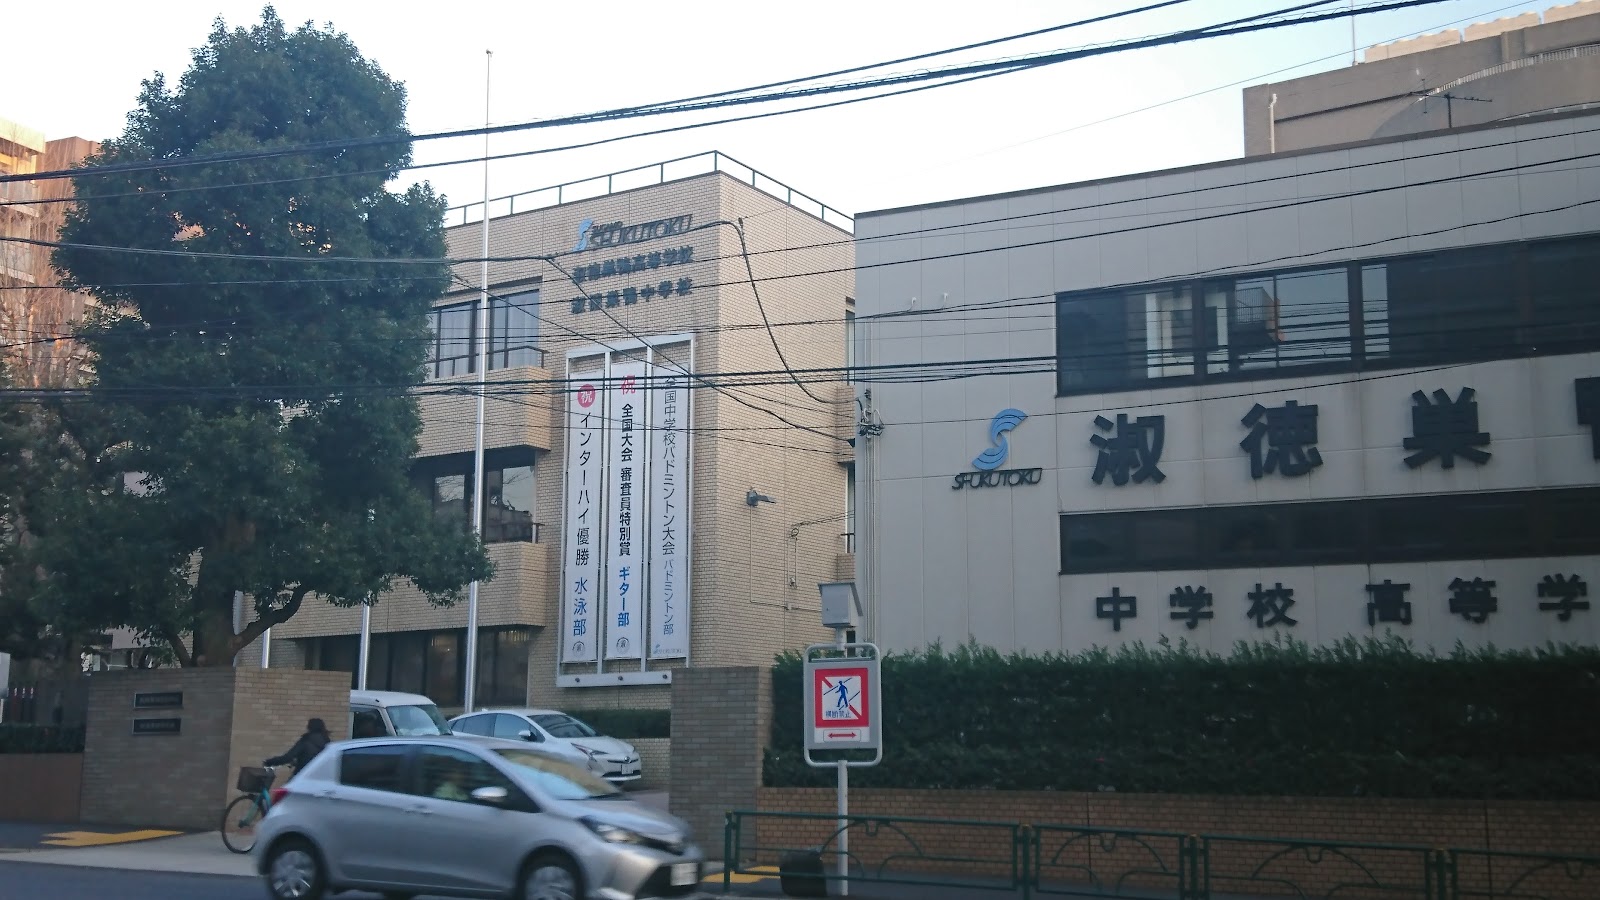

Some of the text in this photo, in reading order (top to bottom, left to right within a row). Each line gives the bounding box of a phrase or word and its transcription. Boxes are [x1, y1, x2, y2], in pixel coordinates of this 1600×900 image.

[575, 412, 592, 566] インターハイ優勝
[617, 374, 636, 628] 祝 全国大会 審査員特別賞 ギター部
[951, 467, 1043, 490] SHUKUTOKU
[573, 577, 588, 637] 水泳部
[663, 559, 675, 635] バドミントン部
[1096, 573, 1590, 632] 中学校 高等学
[825, 710, 851, 718] 横断禁止
